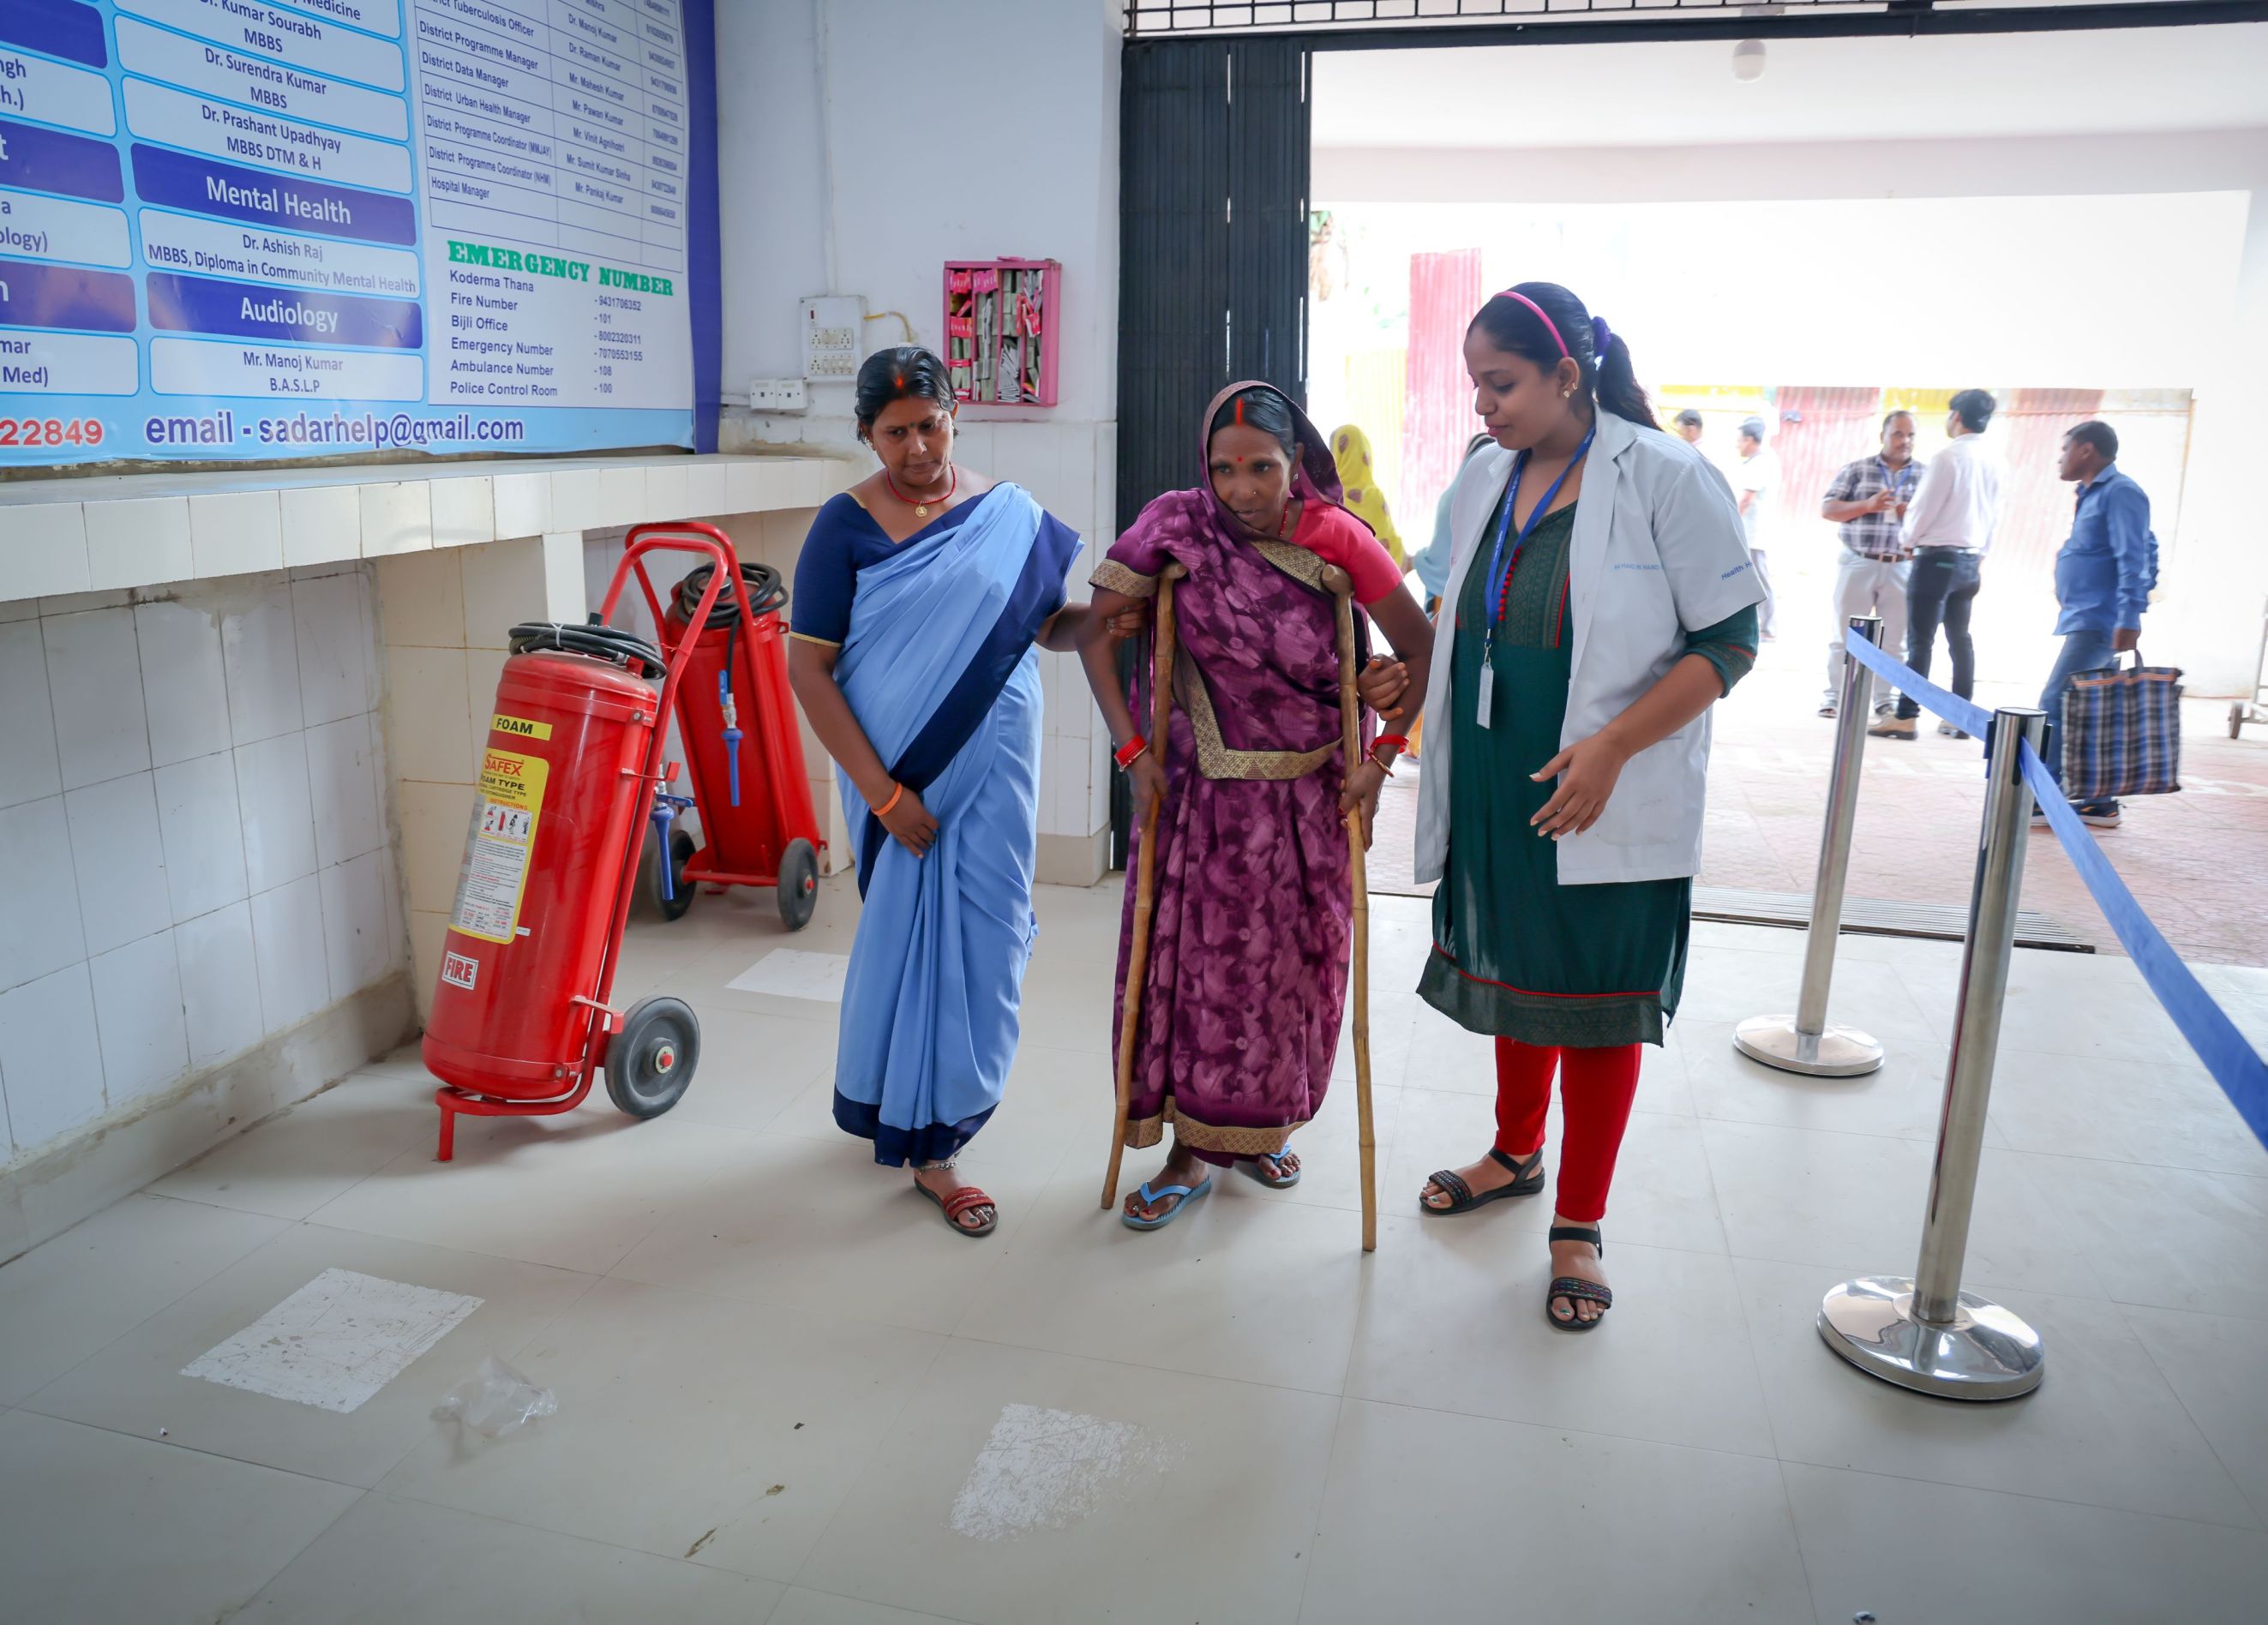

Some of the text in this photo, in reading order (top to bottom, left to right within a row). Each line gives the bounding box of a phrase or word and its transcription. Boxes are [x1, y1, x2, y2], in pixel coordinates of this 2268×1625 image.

[222, 0, 265, 22] Kumar
[268, 11, 322, 40] Sourabh
[453, 0, 534, 37] Tuberculosis Officer
[244, 28, 283, 53] MBBS
[420, 21, 538, 70] District Programme Manager
[205, 47, 327, 95] Dr. Surendra Kumar
[423, 51, 509, 88] District Data Manager
[250, 87, 288, 109] MBBS
[424, 82, 531, 124] District Urban Health Manager
[201, 104, 341, 154] Dr. Prashant Upadhyay
[427, 114, 452, 132] District
[454, 121, 491, 142] Programme
[493, 131, 528, 152] Coordinator
[226, 135, 321, 171] MBBS DTM & H
[429, 145, 455, 163] District
[458, 153, 496, 172] Programme
[497, 161, 533, 180] Coordinator
[207, 175, 351, 225] Mental Health
[431, 176, 490, 201] Hospital Manager
[243, 234, 323, 262] Dr. Ashish Raj
[148, 243, 417, 293] MBBS, Diploma in Community Mental Health
[447, 239, 675, 297] EMERGENCY NUMBER
[450, 269, 534, 292] Koderma Thana
[451, 291, 518, 310] Fire Number
[241, 297, 338, 333] Audiology
[451, 315, 508, 332] Bijli Office
[451, 336, 554, 356] Emergency Number
[243, 351, 344, 372] Mr. Manoj Kumar
[450, 358, 555, 375] Ambulance Number
[3, 365, 49, 388] Med)
[269, 377, 321, 393] B.A.S.L.P
[450, 381, 558, 397] Police Control Room
[146, 411, 234, 444] email
[259, 412, 524, 448] sadarhelp@gmail.com
[1721, 565, 1744, 581] Health
[496, 717, 534, 735] FOAM
[484, 753, 524, 777] SAFEX
[498, 778, 525, 791] TYPE
[445, 956, 474, 983] FIRE
